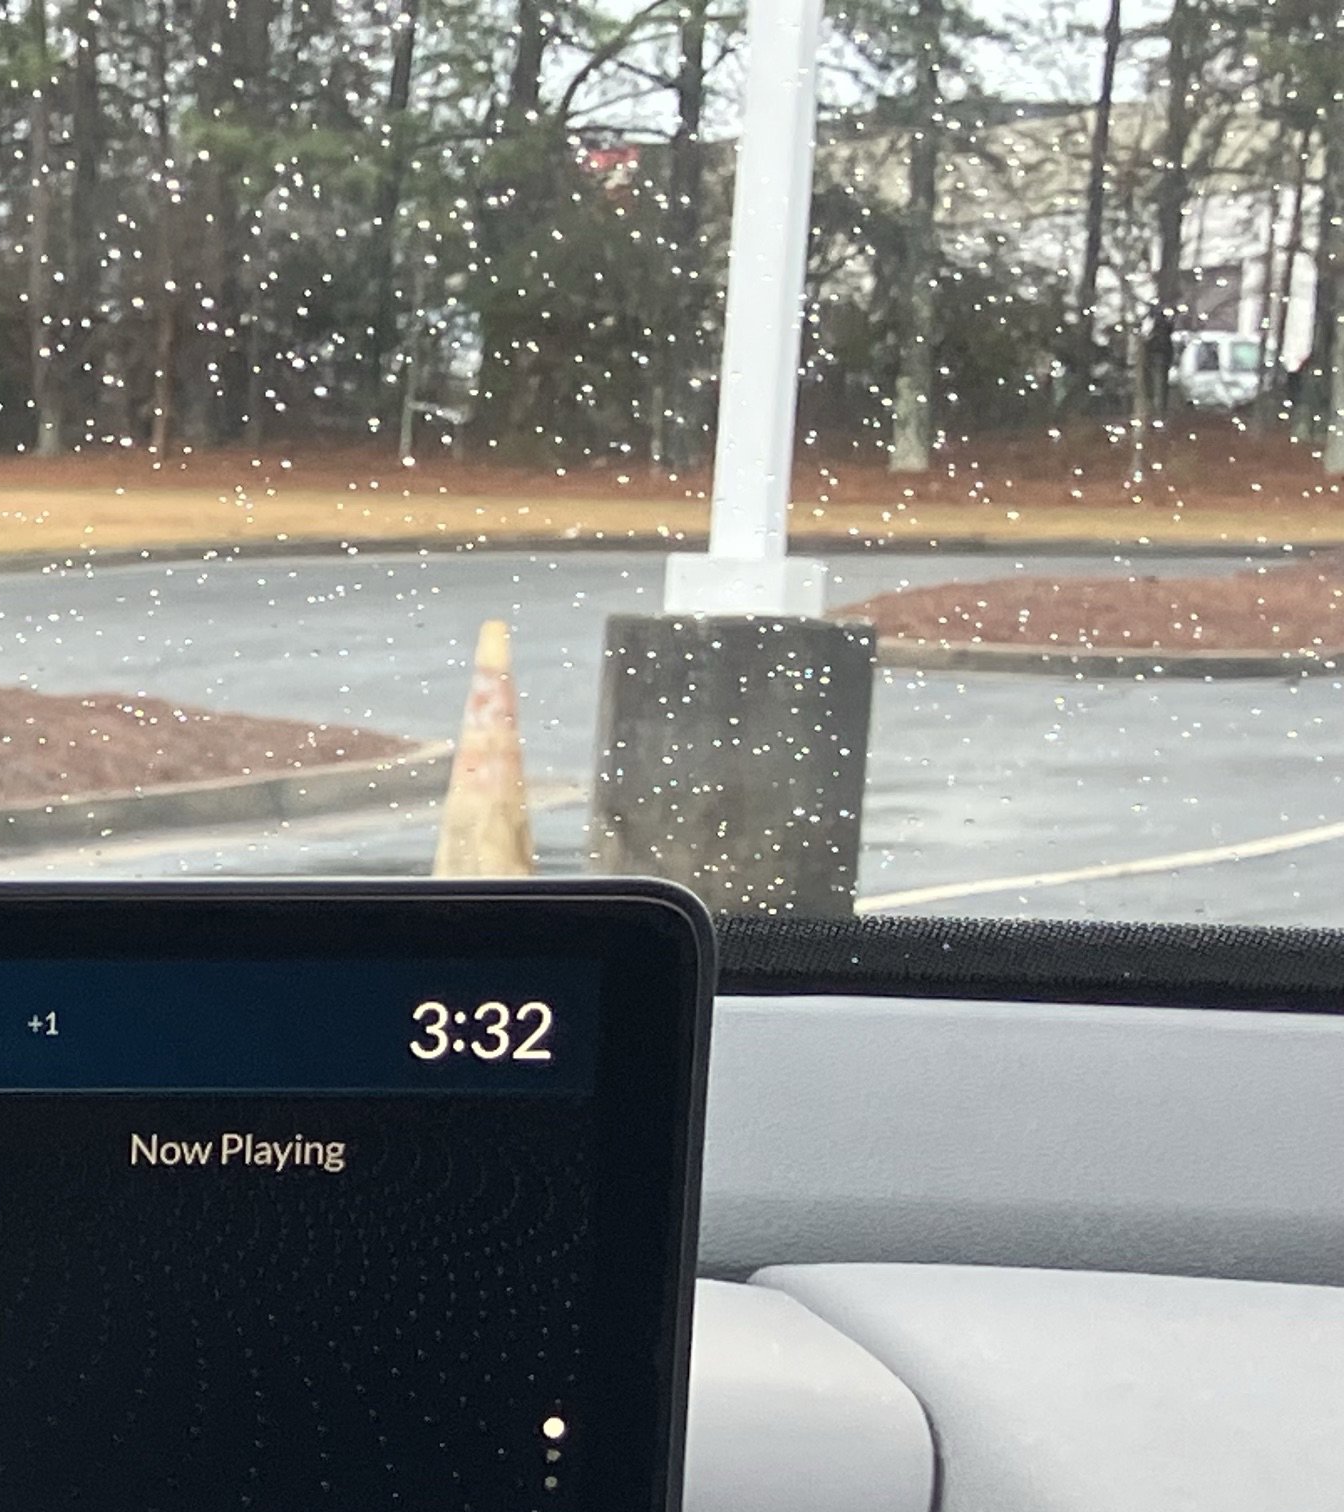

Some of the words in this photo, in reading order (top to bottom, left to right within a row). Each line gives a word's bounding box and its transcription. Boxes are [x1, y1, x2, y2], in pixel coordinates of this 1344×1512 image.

[27, 1011, 60, 1036] +1
[409, 1001, 553, 1061] 3:32
[129, 1133, 212, 1166] Now
[220, 1132, 346, 1173] Playing
